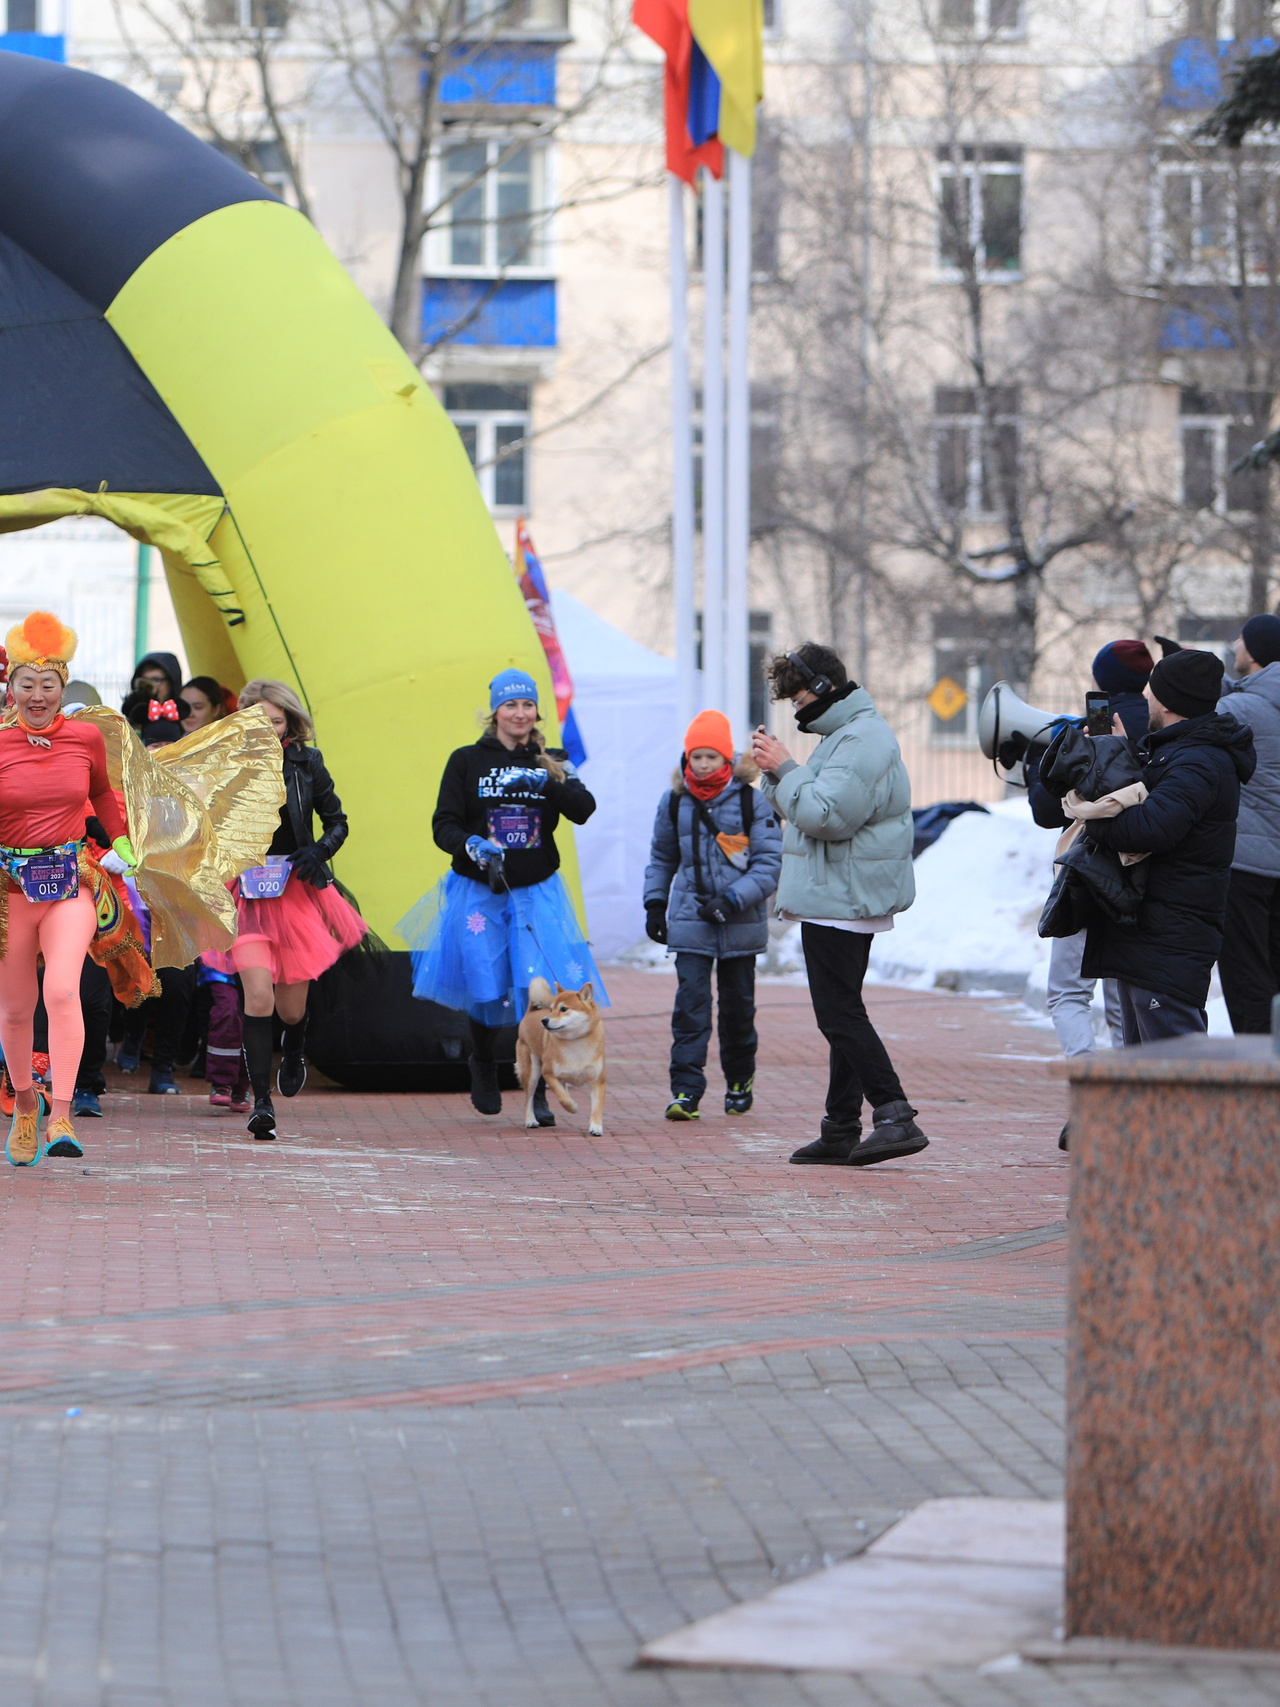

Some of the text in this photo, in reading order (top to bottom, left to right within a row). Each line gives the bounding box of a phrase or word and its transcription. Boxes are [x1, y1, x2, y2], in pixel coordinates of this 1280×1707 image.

[506, 832, 527, 843] 078
[50, 872, 65, 880] 2023
[38, 882, 58, 895] 013
[258, 881, 280, 892] 020
